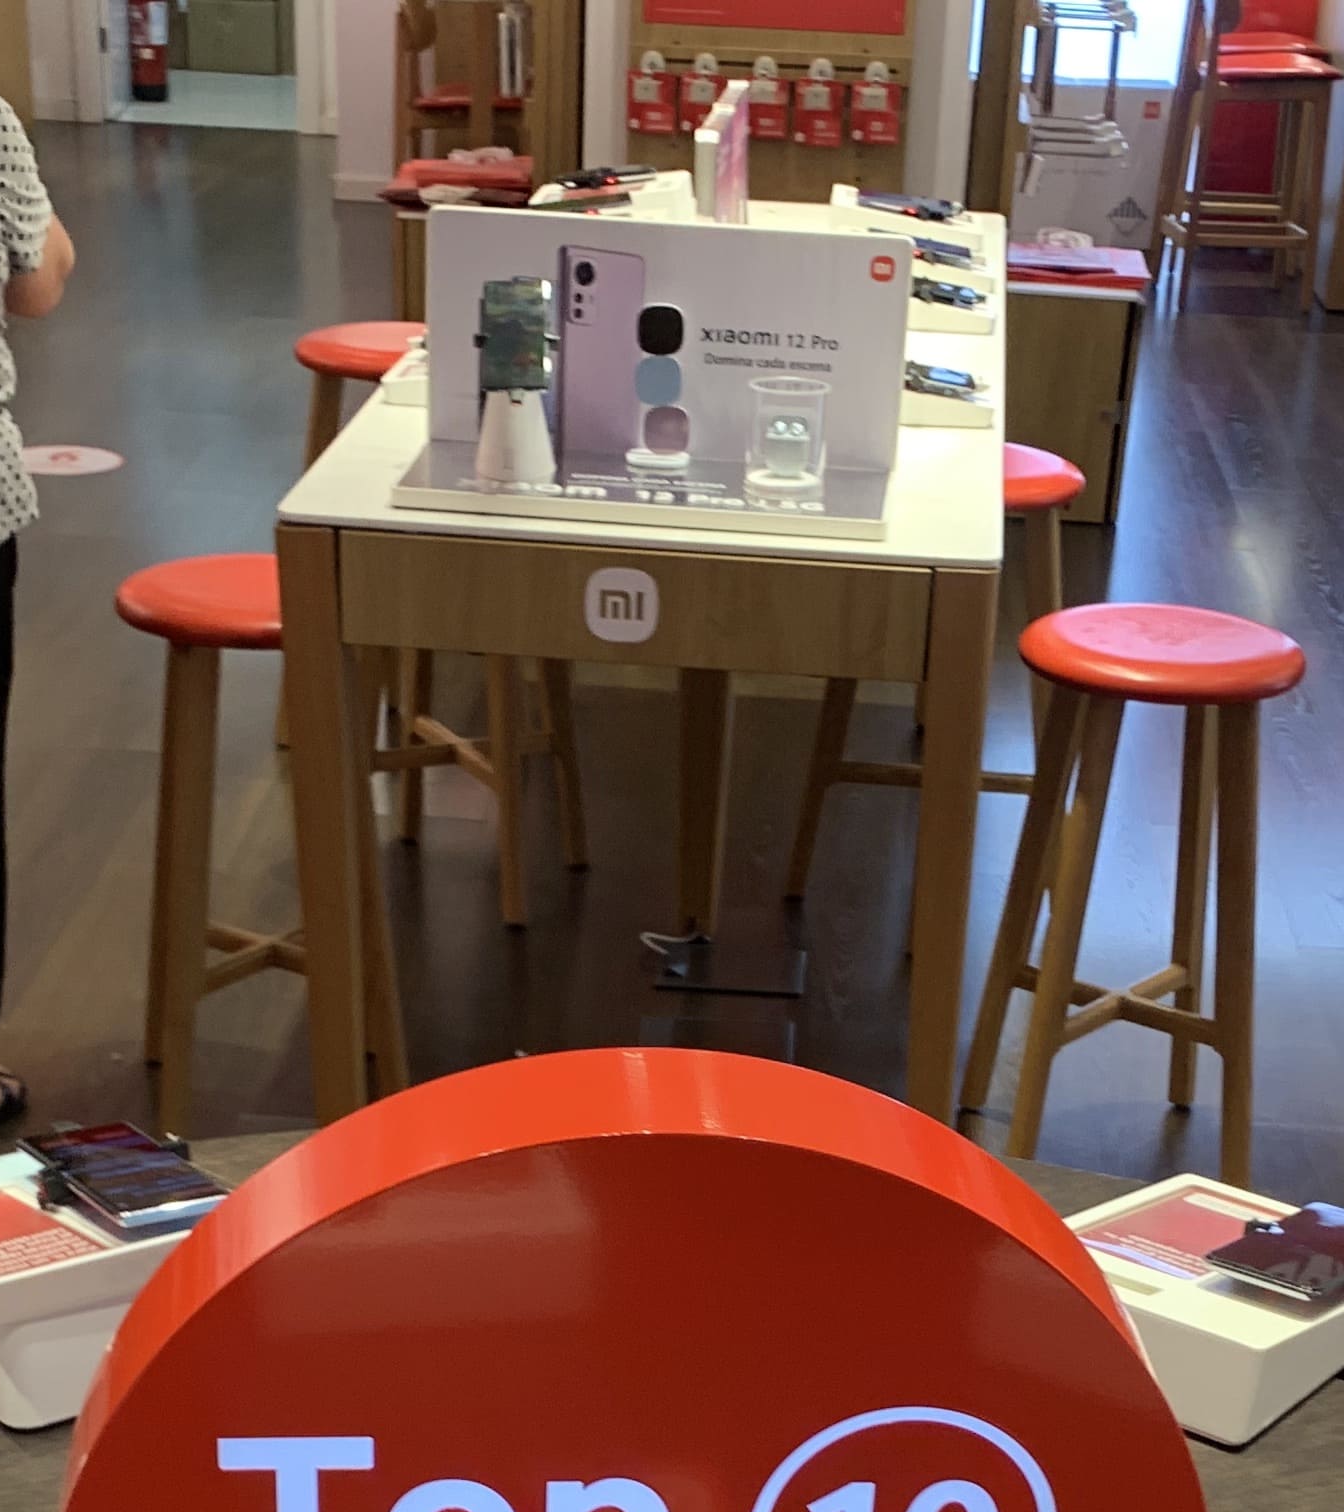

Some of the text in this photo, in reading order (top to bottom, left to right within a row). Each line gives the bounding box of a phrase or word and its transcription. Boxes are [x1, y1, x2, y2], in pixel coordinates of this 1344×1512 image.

[701, 327, 839, 351] xiaomi 12 Pro
